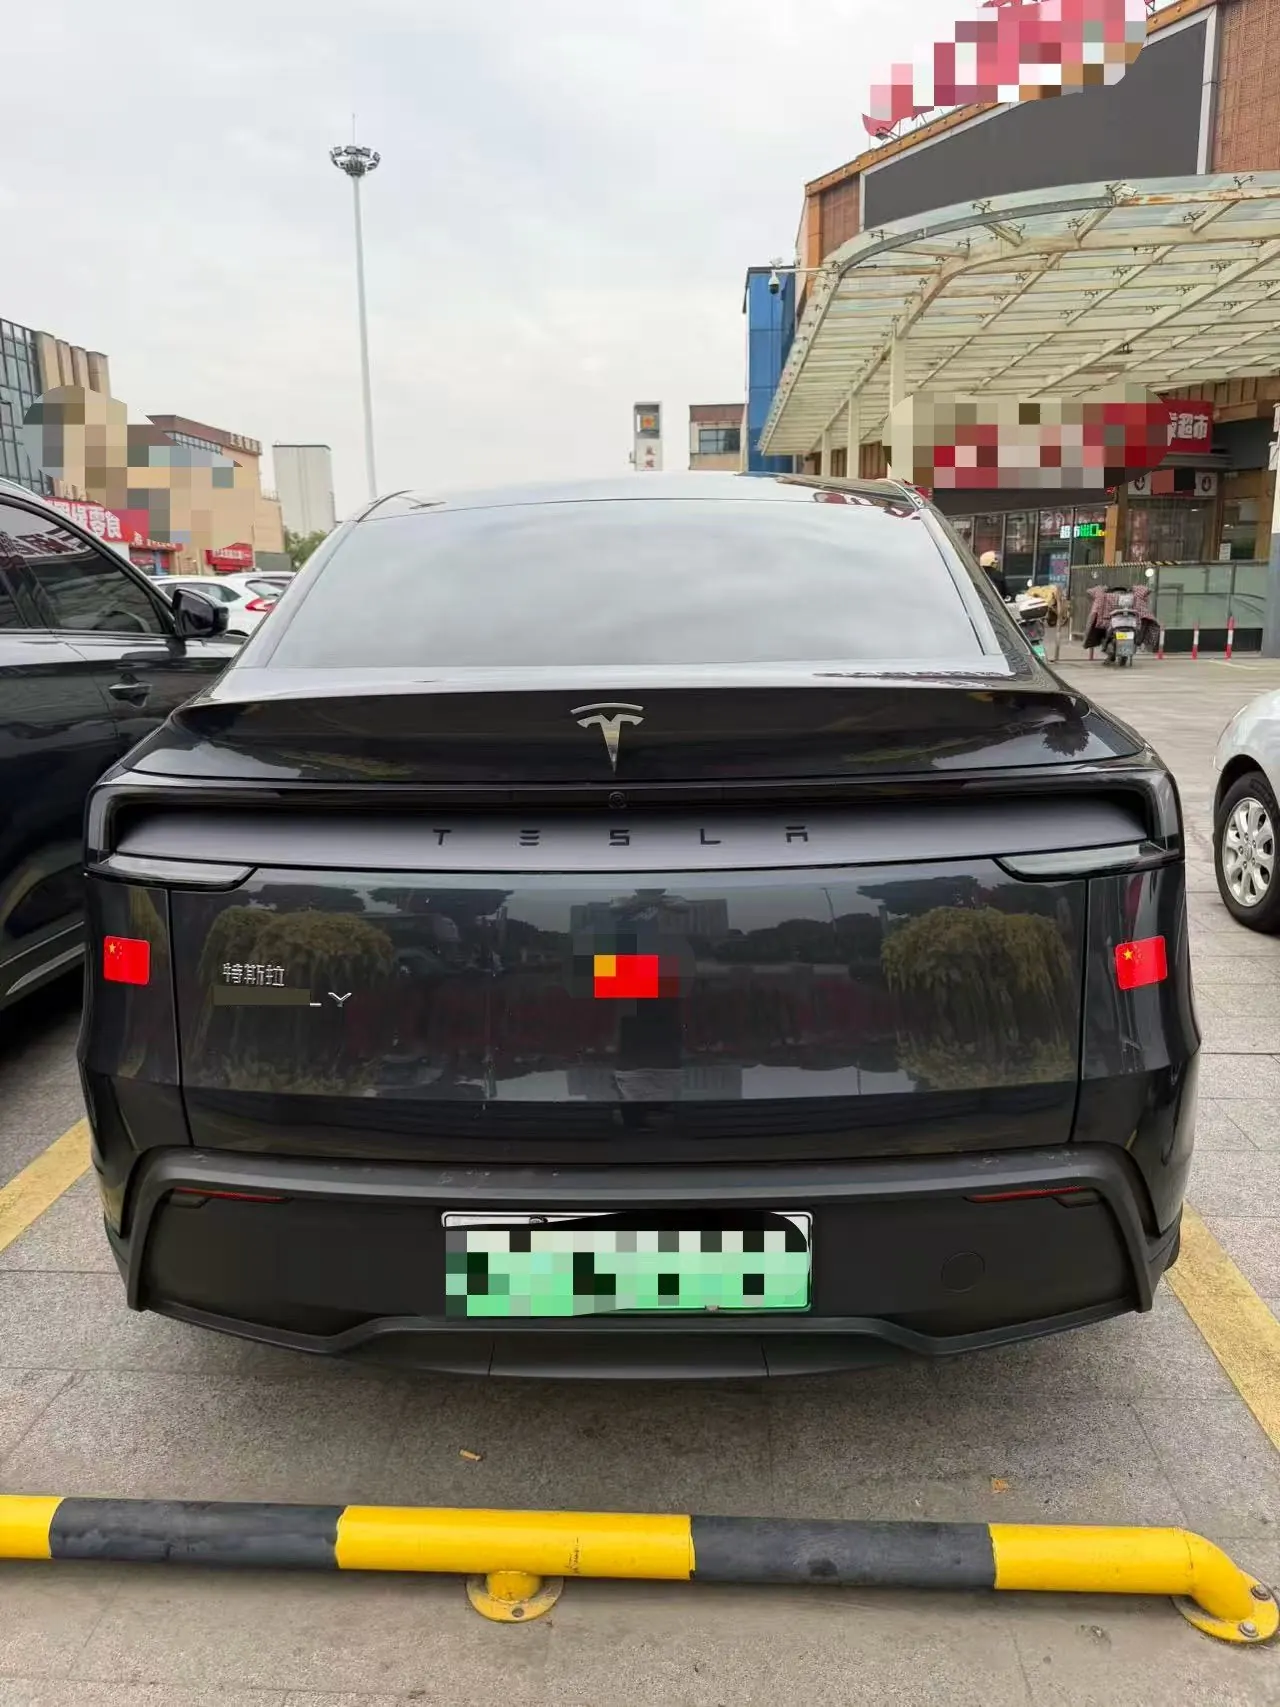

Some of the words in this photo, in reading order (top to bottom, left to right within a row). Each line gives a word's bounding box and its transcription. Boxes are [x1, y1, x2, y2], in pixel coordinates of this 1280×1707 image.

[432, 825, 809, 848] TESLA
[223, 962, 285, 987] 特斯拉
[328, 991, 353, 1008] Y
